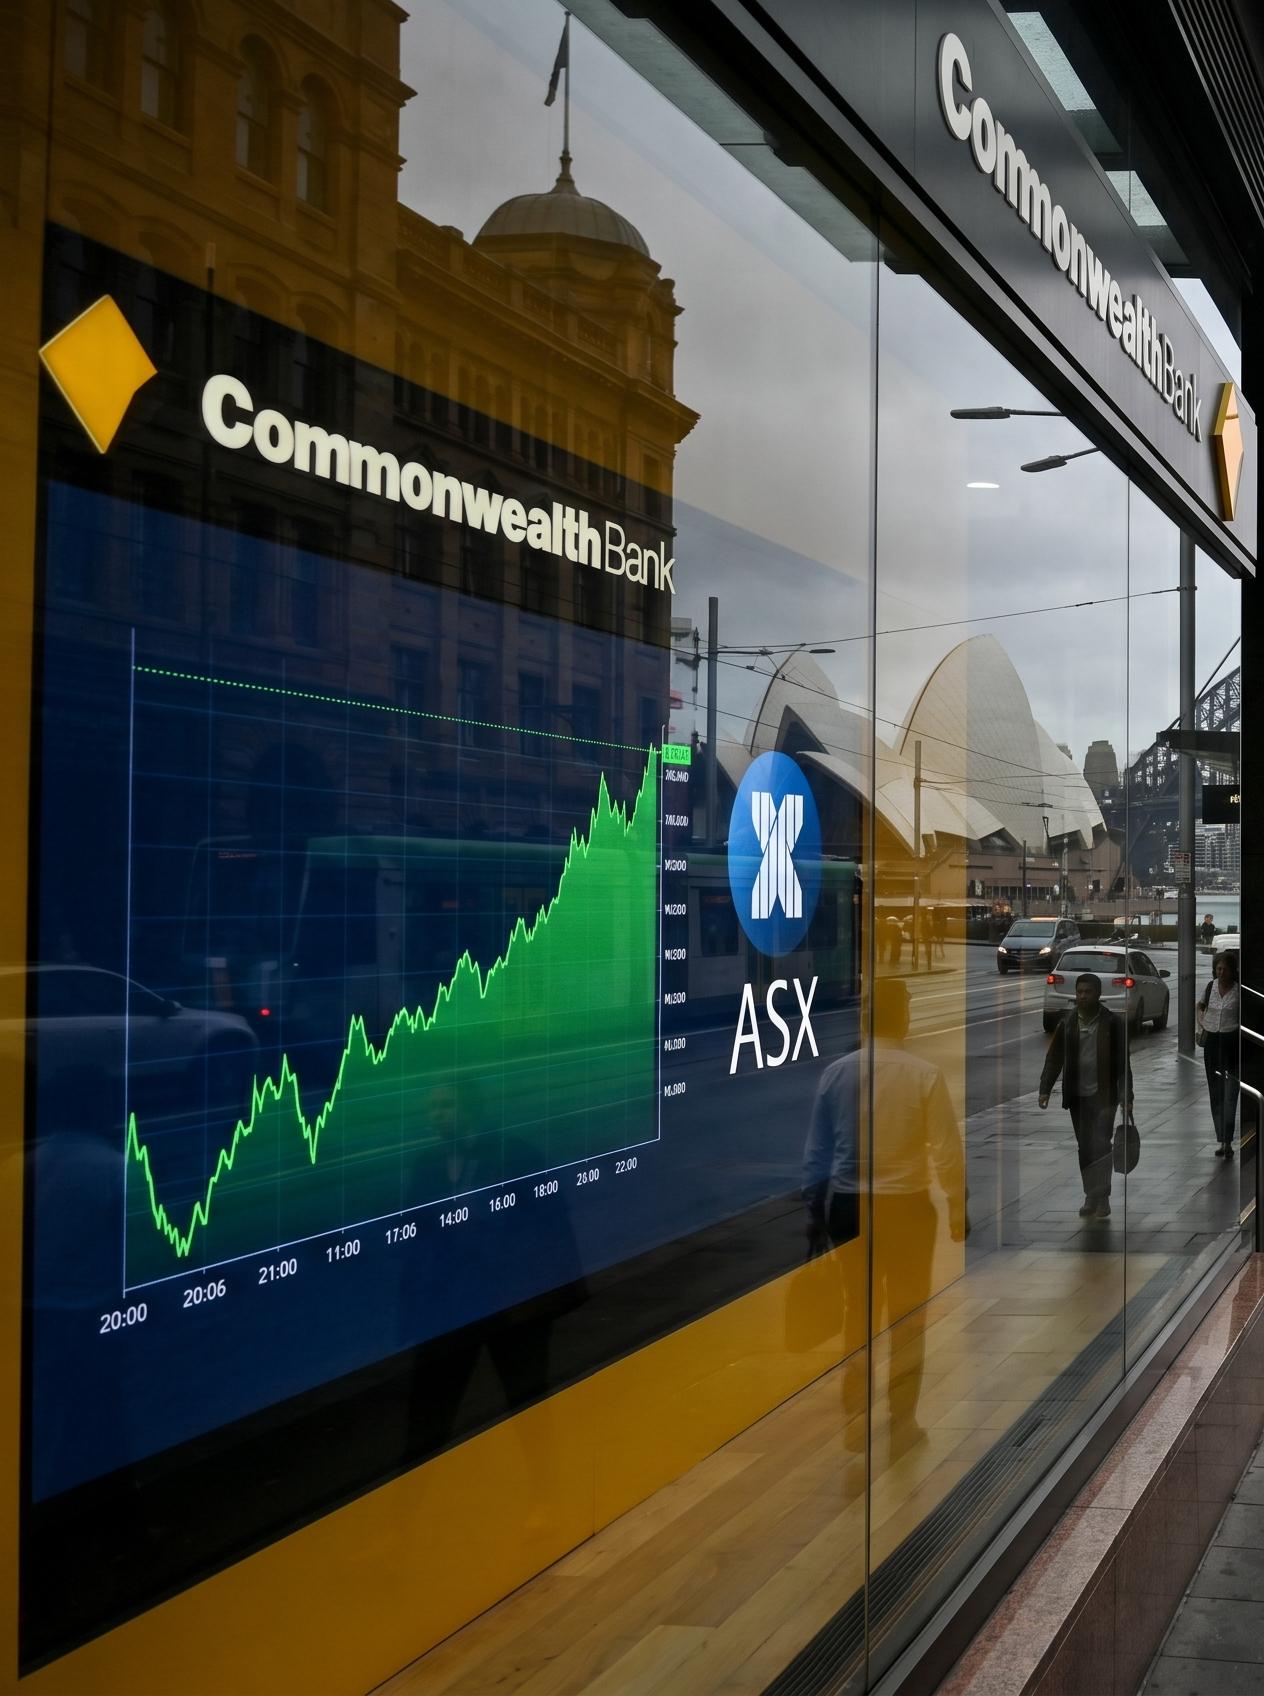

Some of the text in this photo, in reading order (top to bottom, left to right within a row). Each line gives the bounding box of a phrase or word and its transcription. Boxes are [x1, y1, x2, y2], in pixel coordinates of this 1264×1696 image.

[730, 976, 820, 1074] ASX
[533, 1180, 559, 1198] 18:00
[439, 1206, 469, 1228] 14:00
[385, 1222, 417, 1244] 17:06
[326, 1239, 361, 1263] 11:00
[258, 1258, 298, 1285] 21:00
[183, 1279, 227, 1308] 20:06
[99, 1303, 148, 1334] 20:00
